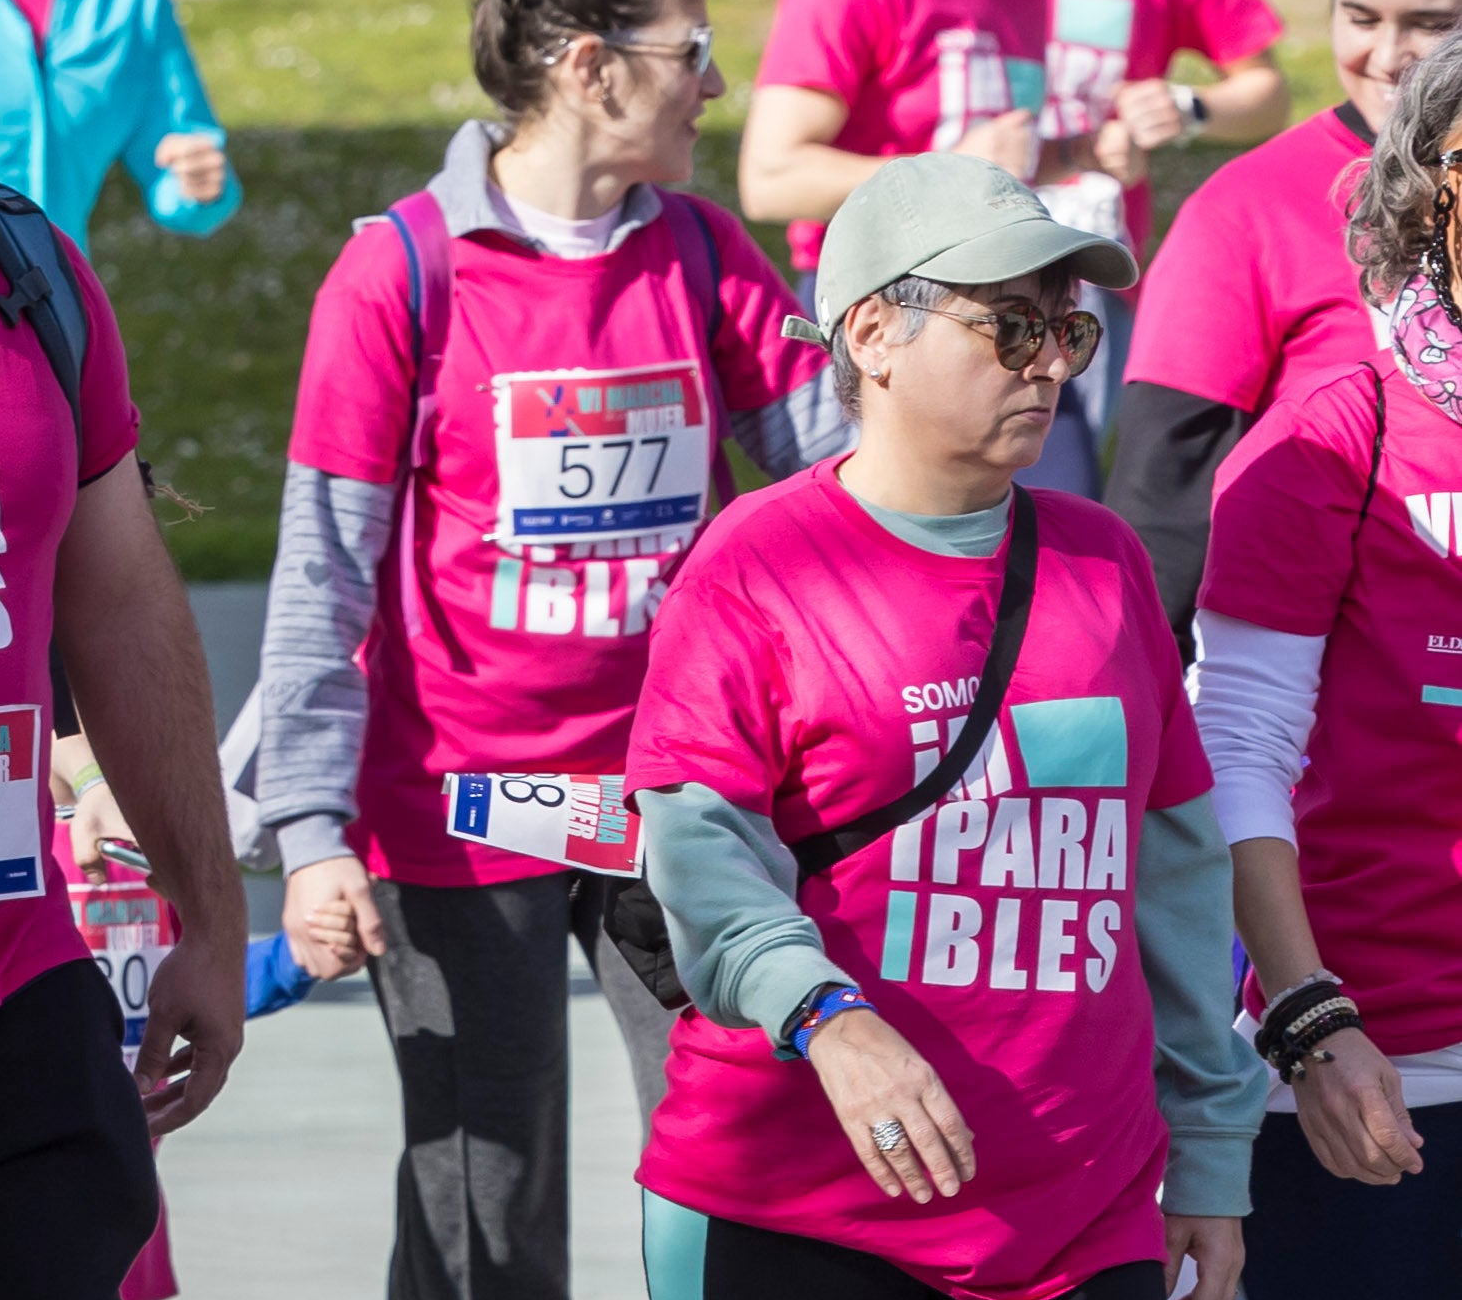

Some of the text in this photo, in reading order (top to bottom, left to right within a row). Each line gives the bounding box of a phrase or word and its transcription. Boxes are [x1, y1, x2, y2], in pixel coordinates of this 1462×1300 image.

[558, 436, 670, 499] 577
[901, 676, 981, 714] SOMO
[932, 796, 1127, 891] PARA
